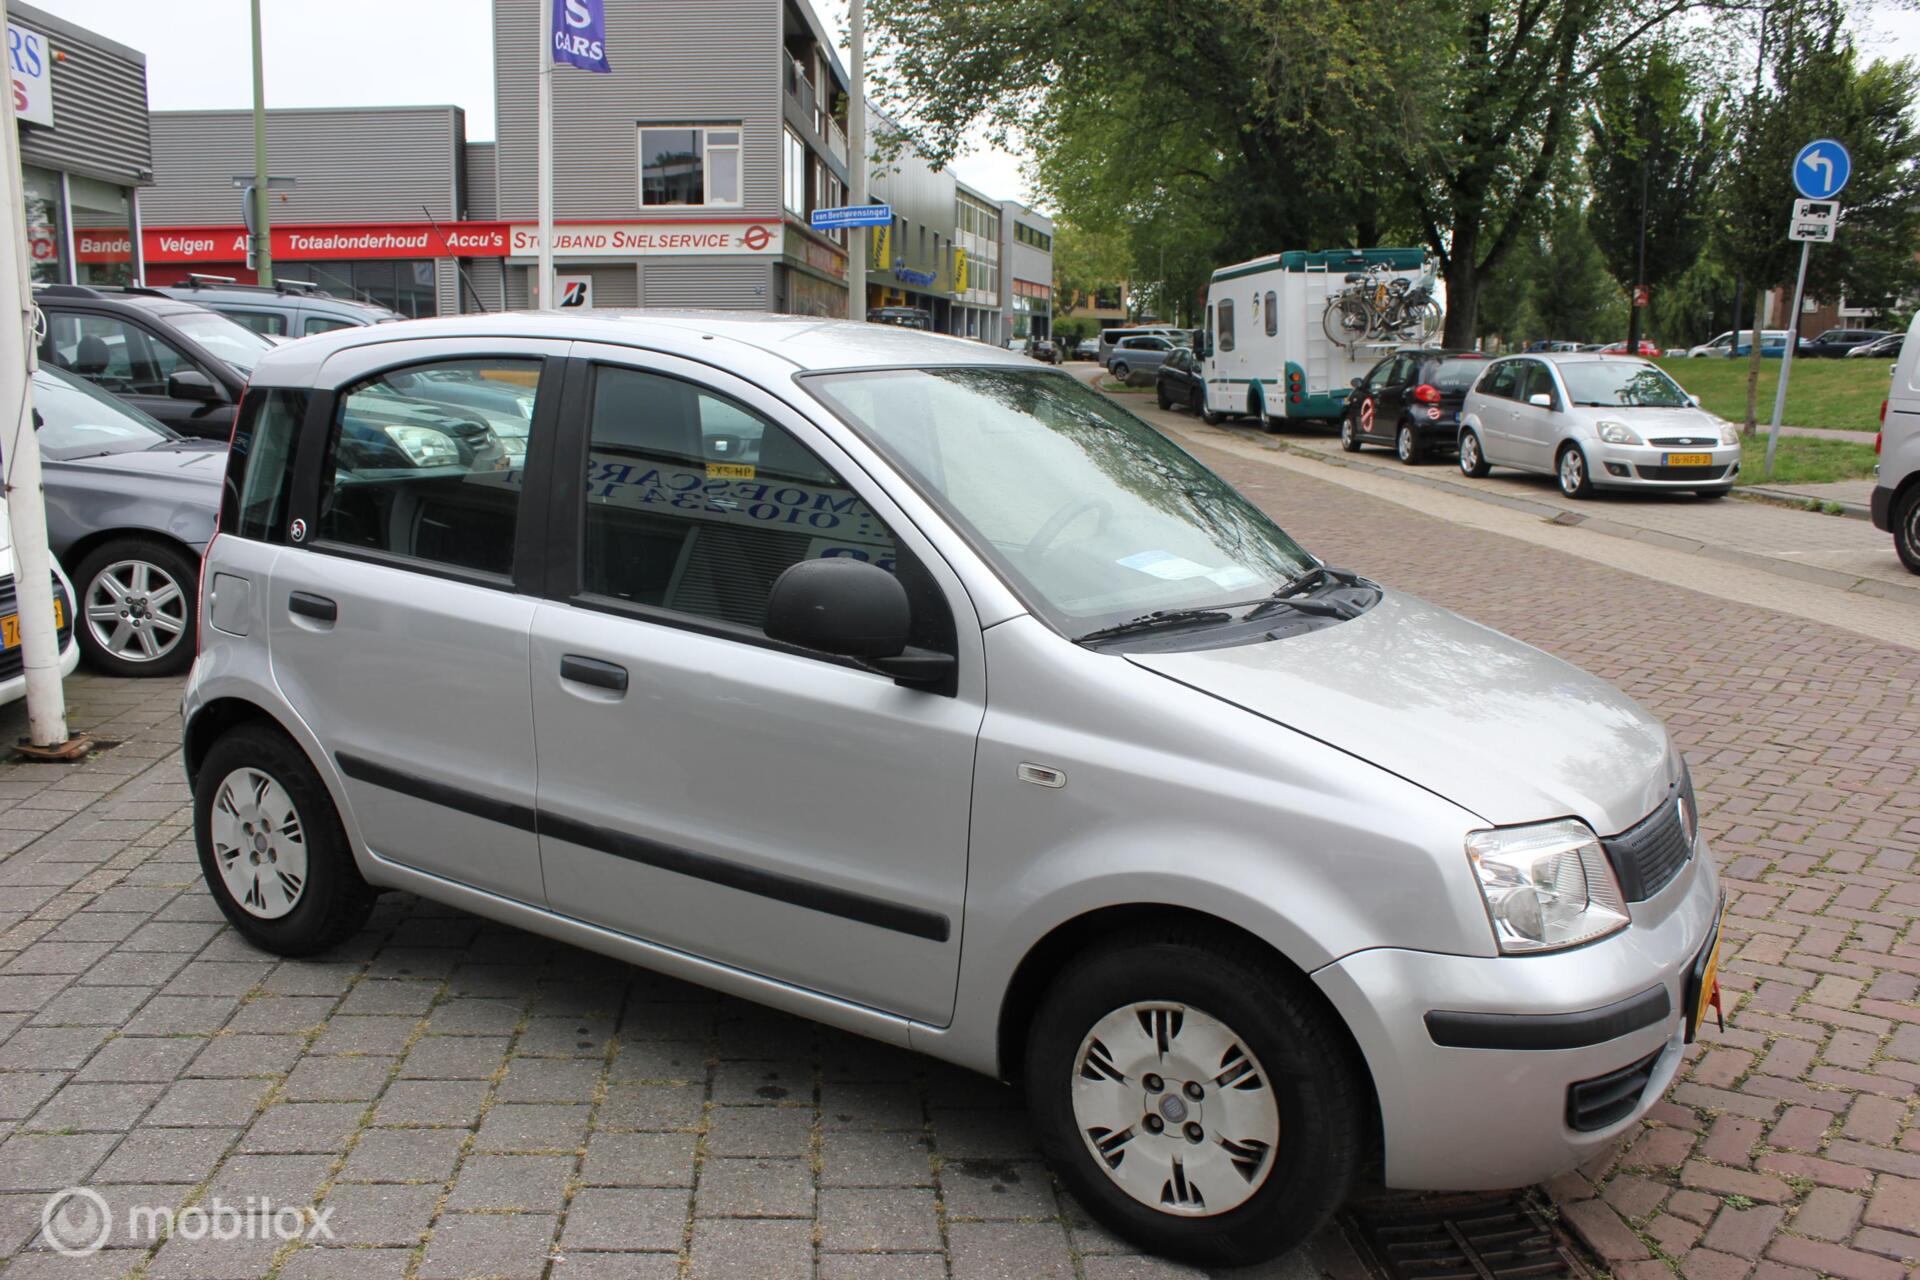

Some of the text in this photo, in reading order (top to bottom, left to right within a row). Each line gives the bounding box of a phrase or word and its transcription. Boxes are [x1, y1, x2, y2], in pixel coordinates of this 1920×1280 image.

[8, 27, 42, 78] RS
[555, 31, 603, 60] CARS
[80, 236, 132, 254] Bande
[159, 236, 214, 255] Velgen
[289, 233, 428, 250] Totaalonderhoud
[446, 231, 503, 248] Accu's
[611, 230, 729, 249] SNELSERVICE
